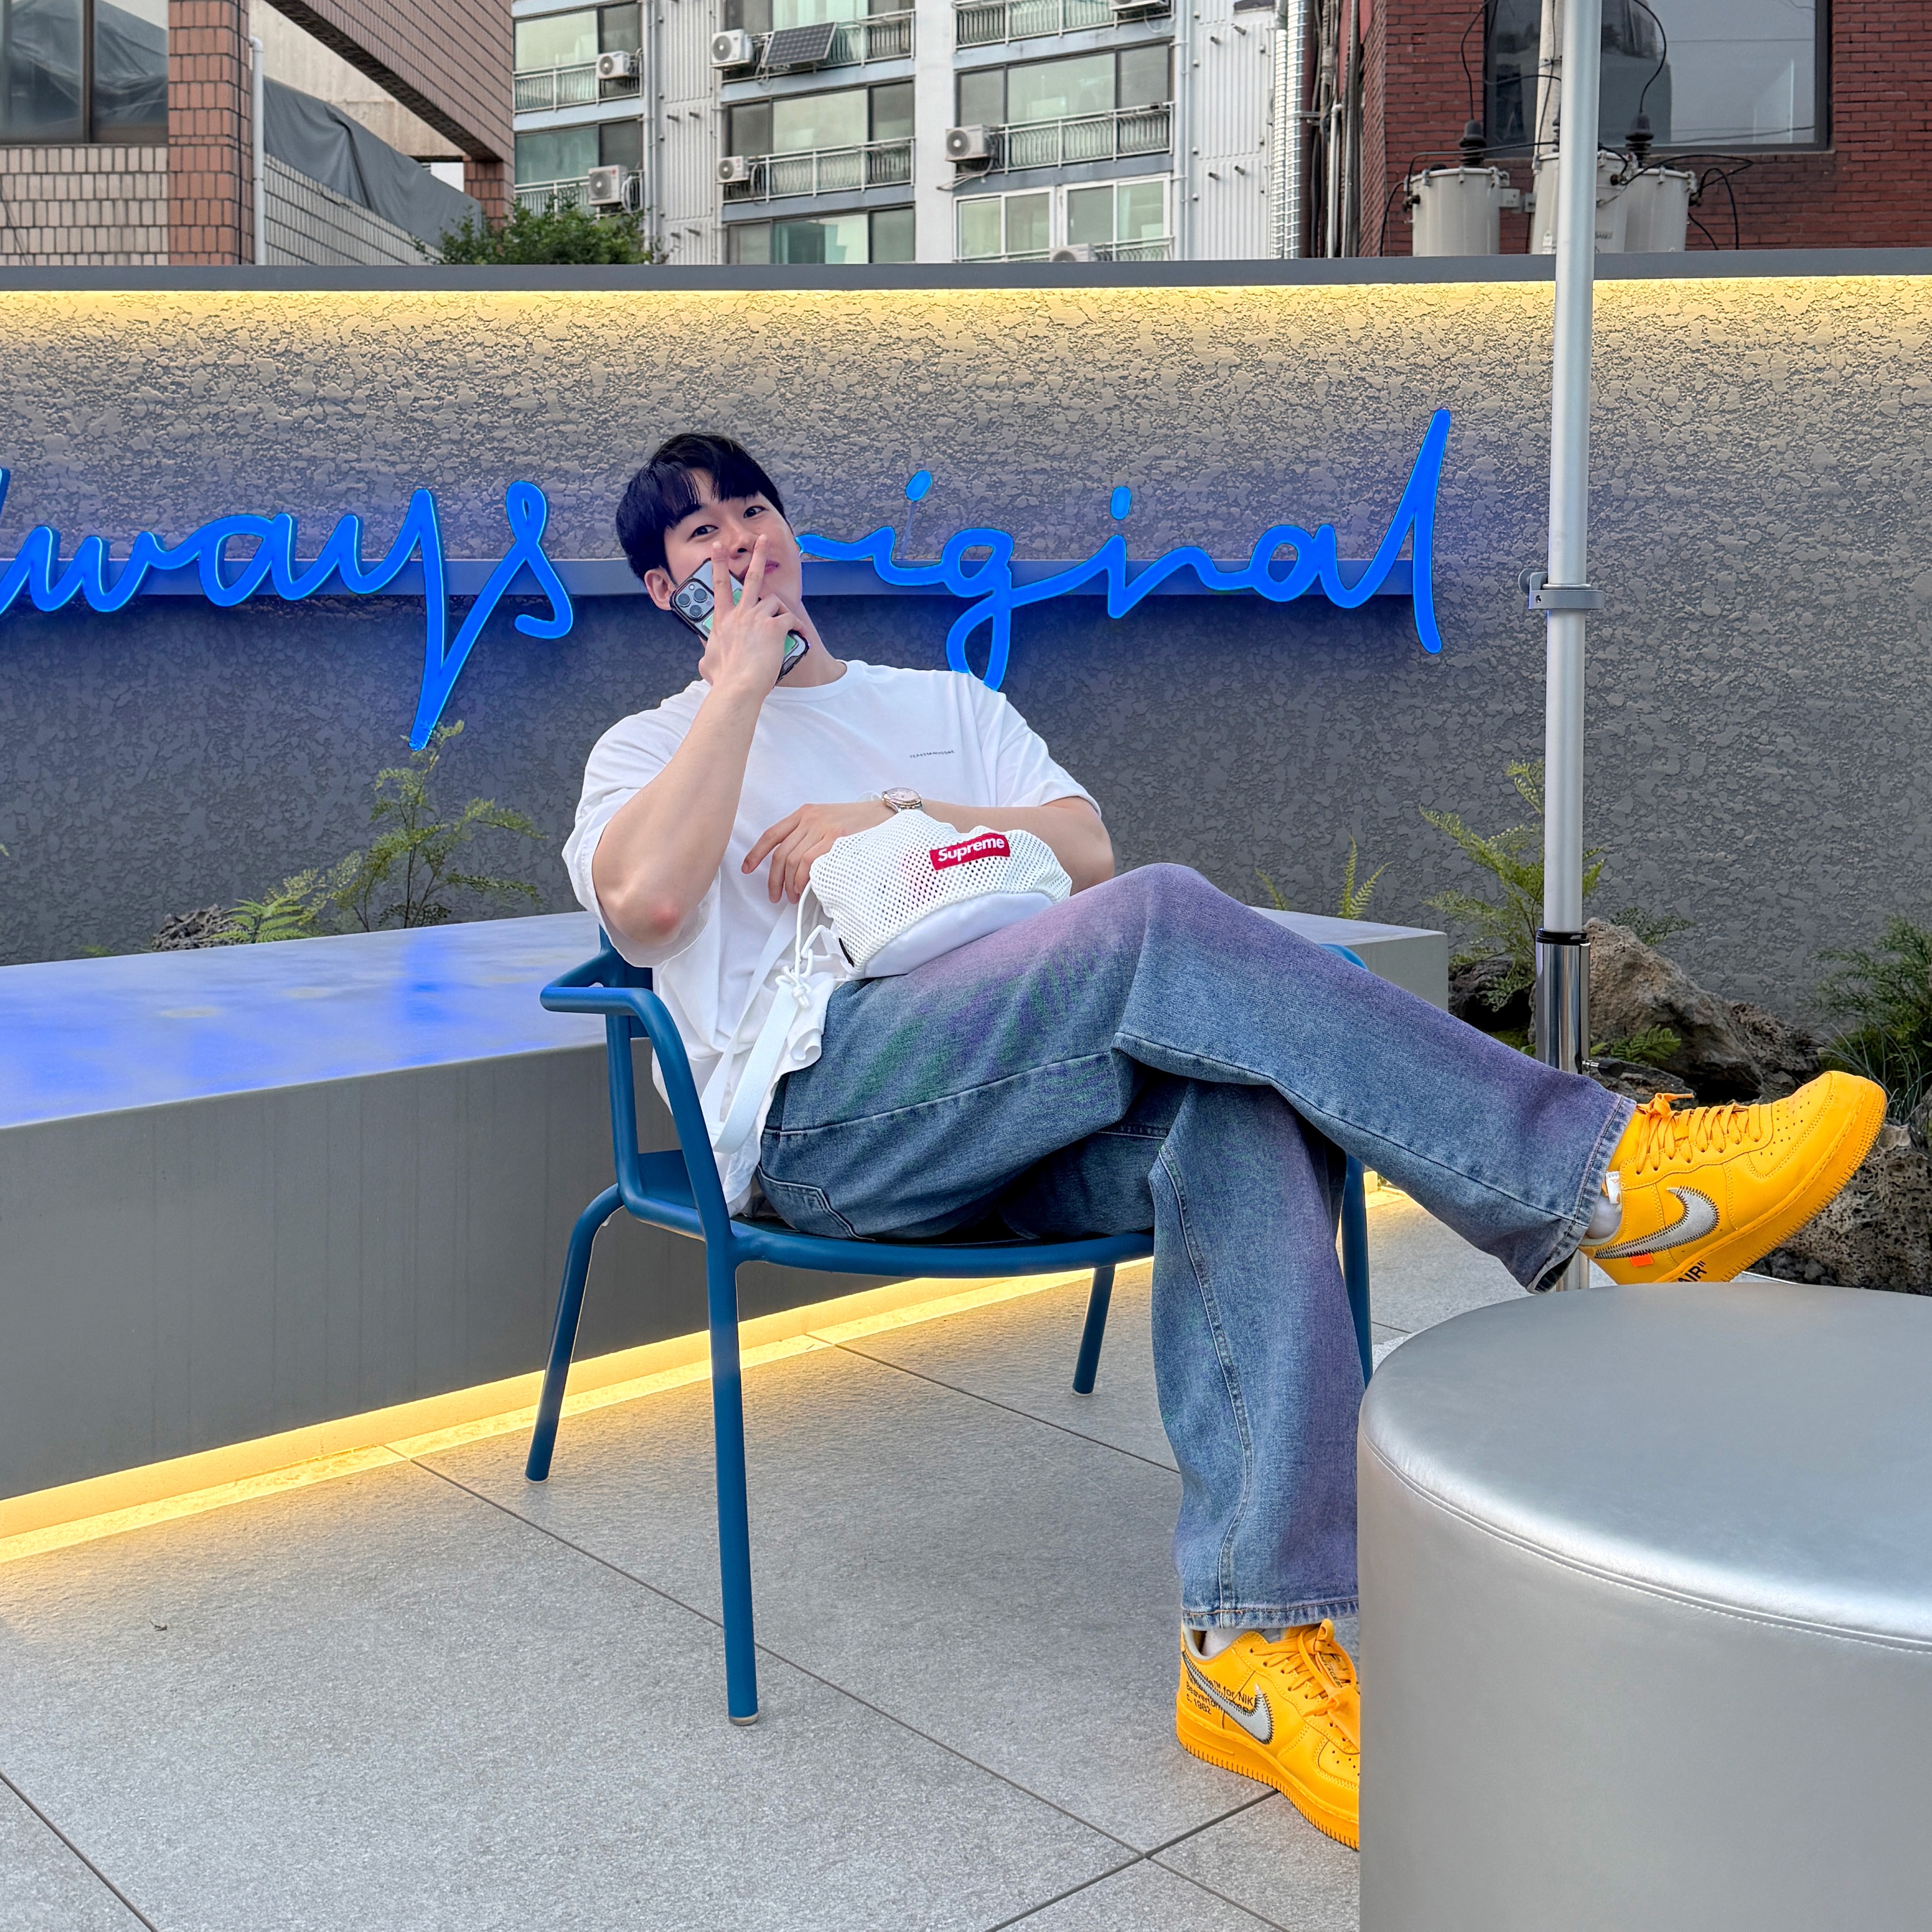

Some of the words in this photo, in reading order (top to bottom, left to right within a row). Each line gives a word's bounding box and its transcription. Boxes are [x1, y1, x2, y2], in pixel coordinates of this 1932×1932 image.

[0, 468, 574, 751] ways
[938, 838, 1005, 862] Supreme
[1238, 1692, 1254, 1706] NIK
